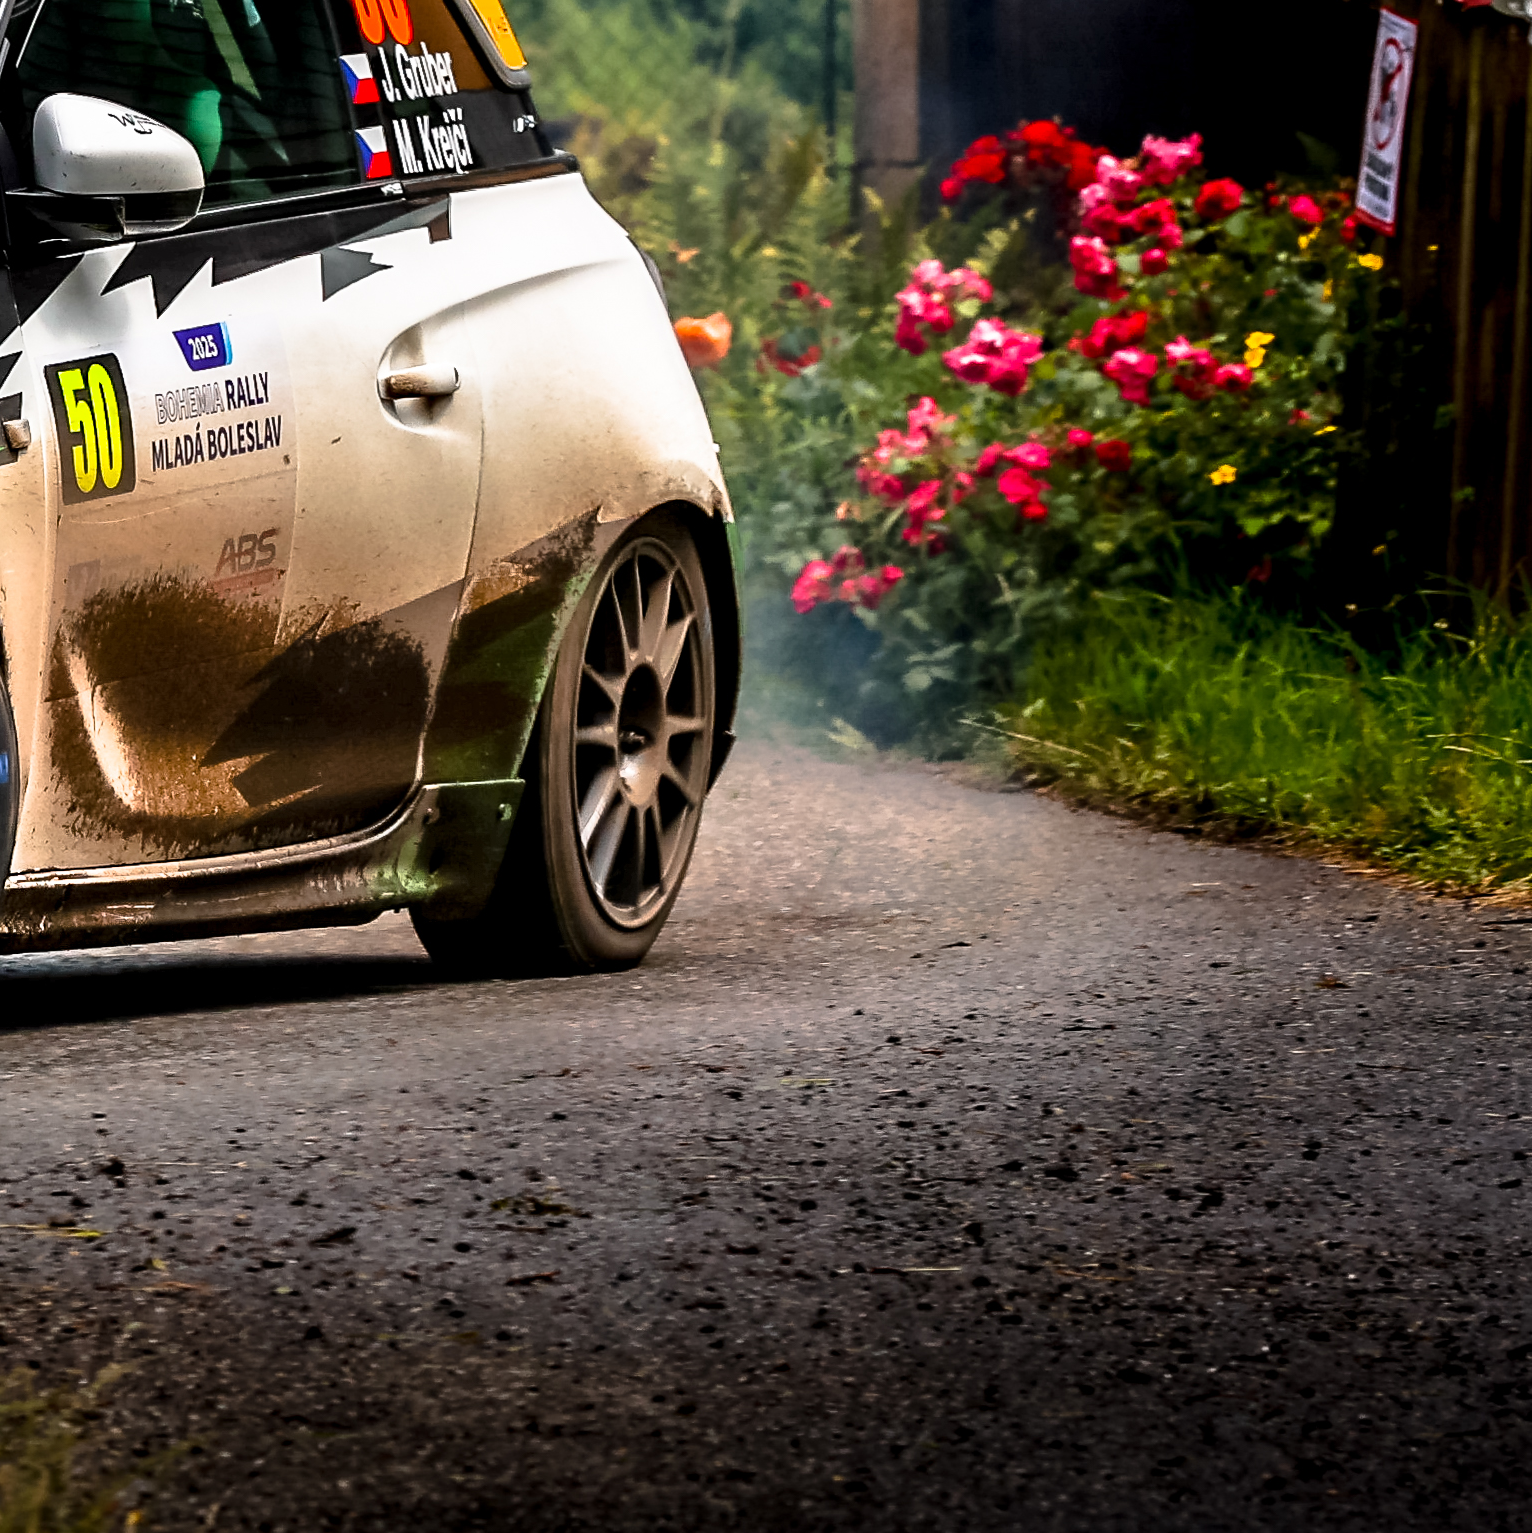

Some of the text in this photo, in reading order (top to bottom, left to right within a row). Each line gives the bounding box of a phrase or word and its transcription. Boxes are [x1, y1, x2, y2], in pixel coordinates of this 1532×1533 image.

[377, 41, 458, 102] J. Gruber
[392, 107, 474, 175] M. Krejčí
[187, 334, 219, 361] 2025
[154, 371, 269, 425] BOHEMIA RALLY
[57, 363, 123, 493] 50
[151, 415, 283, 472] MLADÁ BOLESLAV
